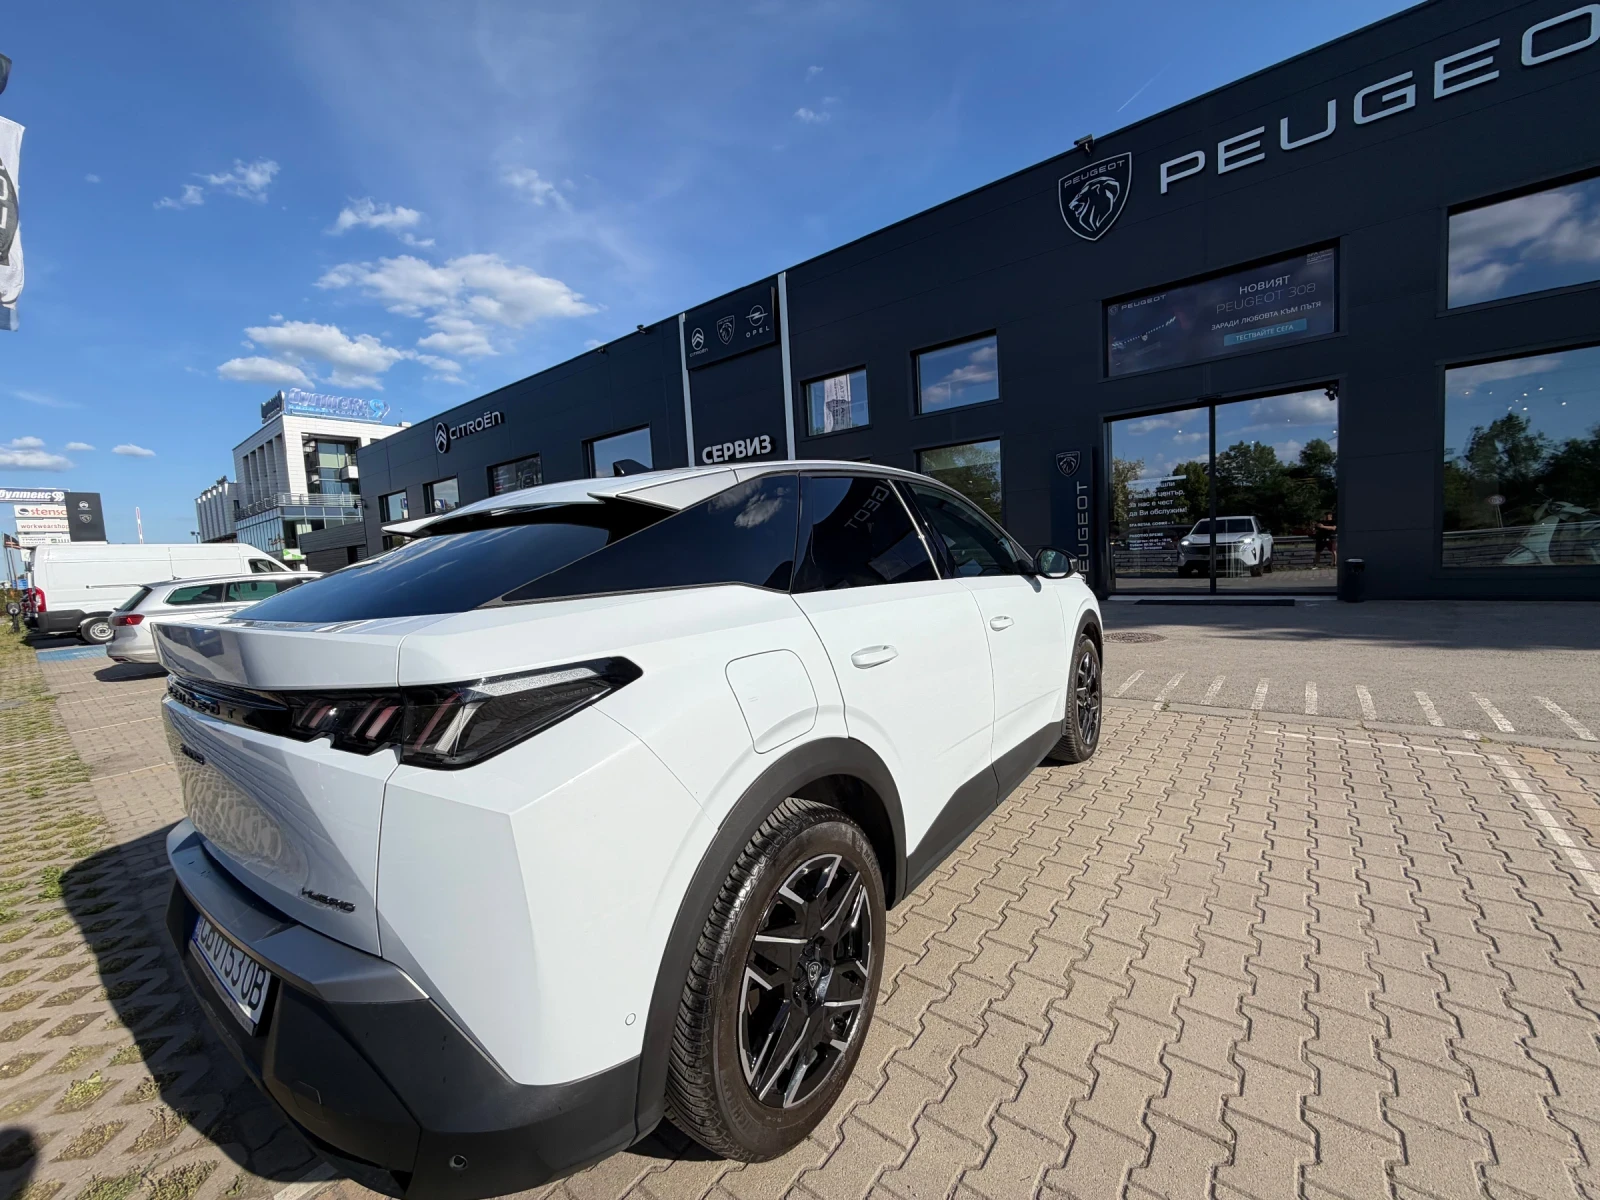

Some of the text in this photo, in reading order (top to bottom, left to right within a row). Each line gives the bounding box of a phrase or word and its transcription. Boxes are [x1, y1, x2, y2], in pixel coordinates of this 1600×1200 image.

[1064, 159, 1126, 189] PEUGEOT
[1239, 274, 1291, 295] НОВИЯТ
[1120, 294, 1167, 311] PEUGEOT
[1216, 282, 1316, 315] PEUGEOT 308
[1211, 300, 1322, 331] ЗАРАДИ ЛЮБОВТА КЪМ ПЪТЯ
[745, 325, 770, 339] OPEL
[1235, 323, 1294, 342] ТЕСТВАЙТЕ СЕГА
[449, 411, 501, 440] CITROËN
[702, 434, 772, 465] СЕРВИЗ
[1149, 506, 1187, 515] обслужим!
